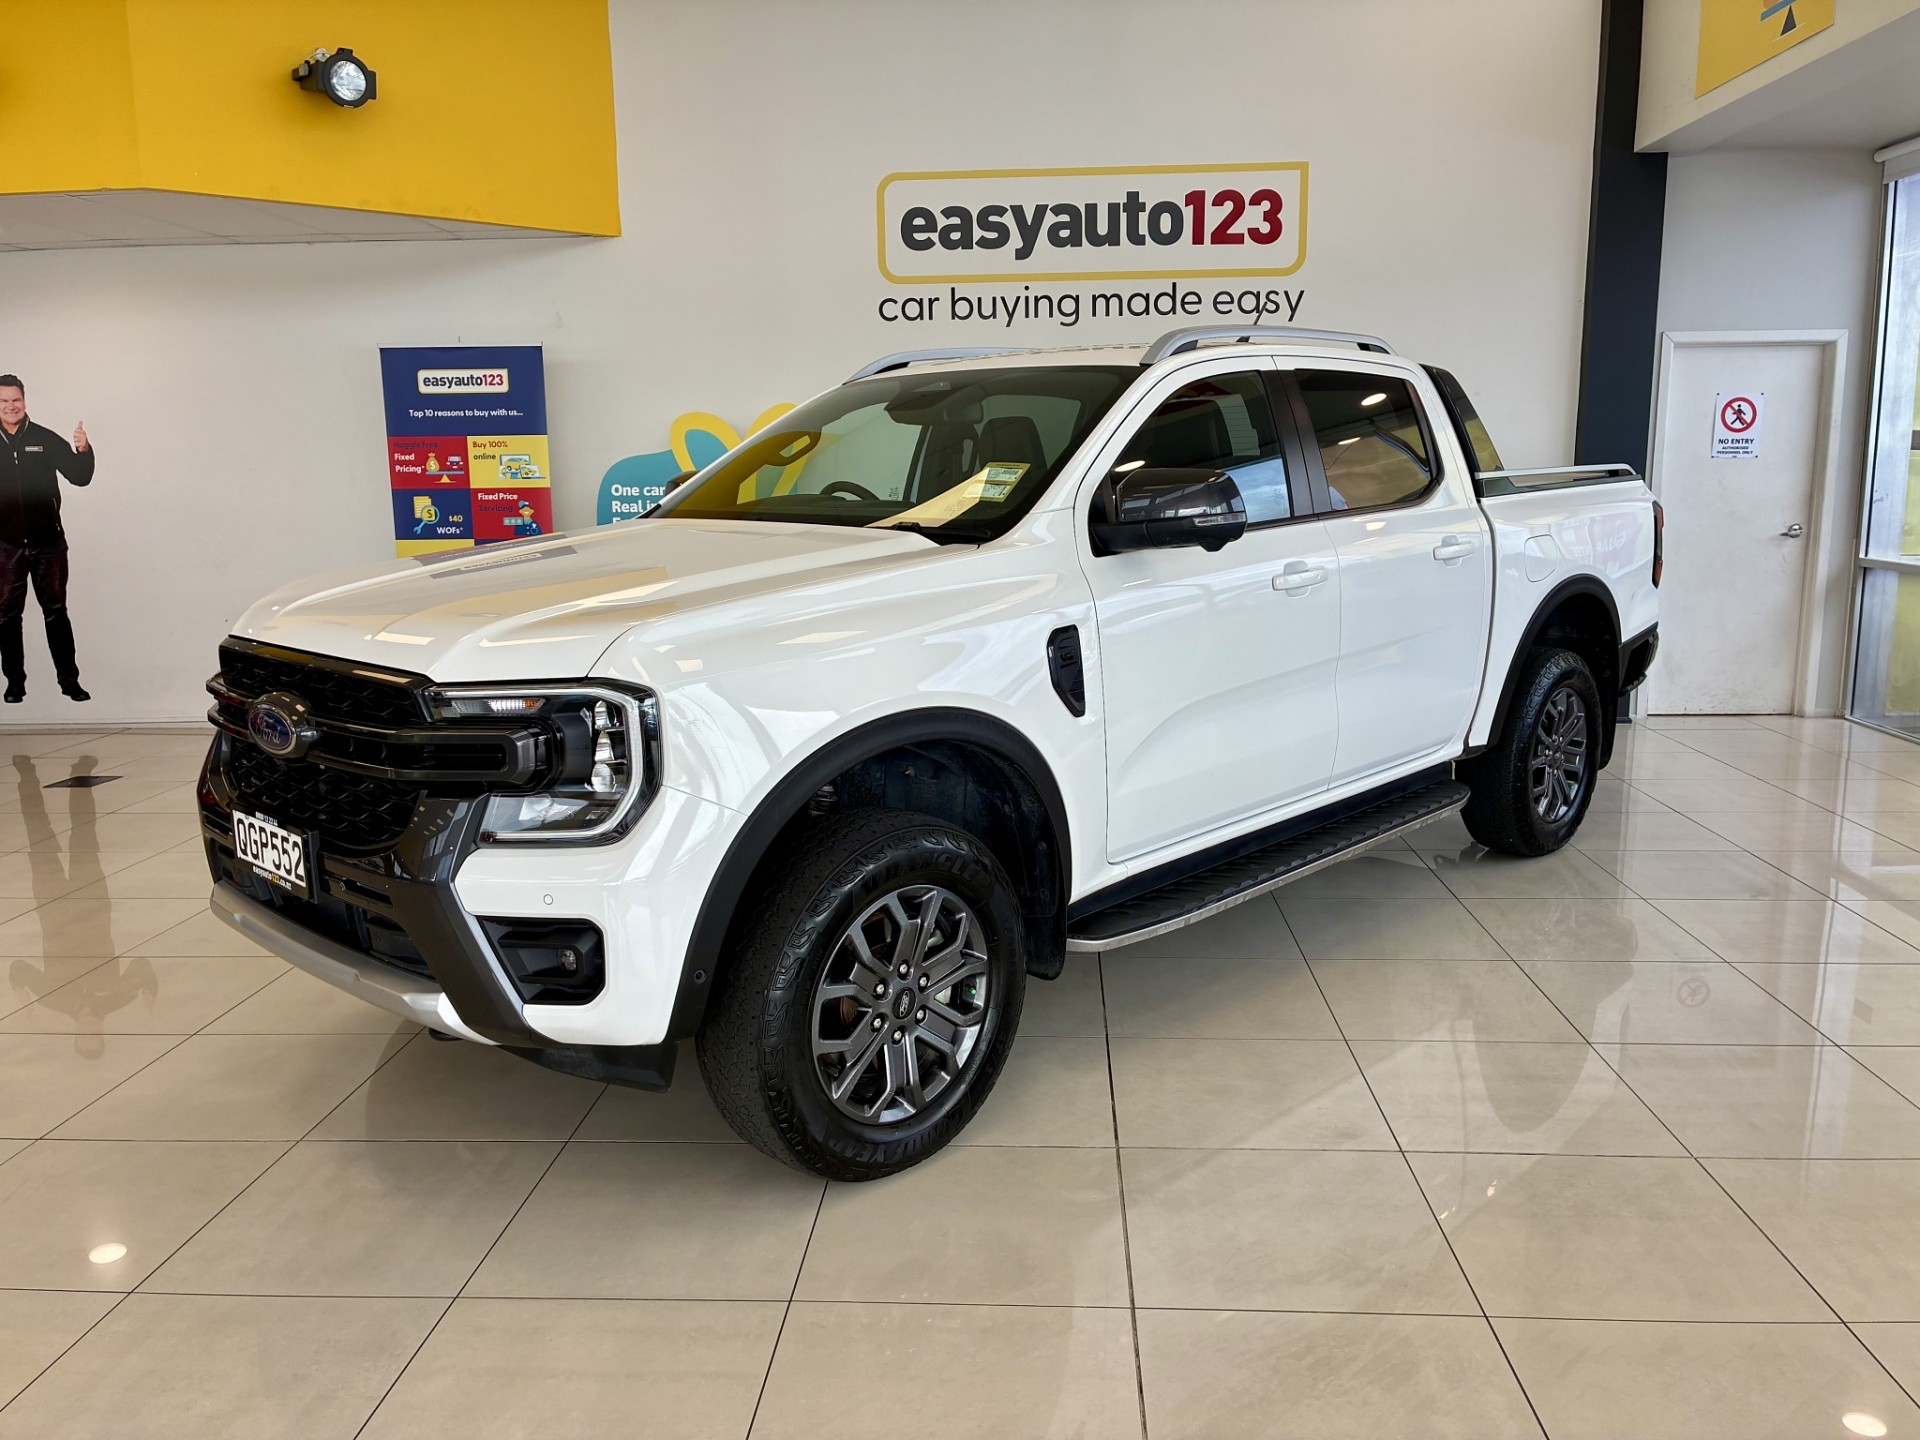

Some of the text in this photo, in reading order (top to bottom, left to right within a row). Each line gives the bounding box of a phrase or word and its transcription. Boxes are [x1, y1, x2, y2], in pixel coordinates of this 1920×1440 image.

[900, 188, 1284, 261] easyauto123
[877, 282, 1306, 327] car buying made easy
[423, 374, 504, 388] easyauto123
[474, 409, 489, 417] buy
[490, 408, 507, 416] with
[472, 441, 486, 450] Buy
[394, 453, 415, 461] Fixed
[611, 484, 666, 496] One car
[611, 500, 643, 512] Real
[256, 713, 281, 744] Ford
[236, 817, 305, 883] QGP552
